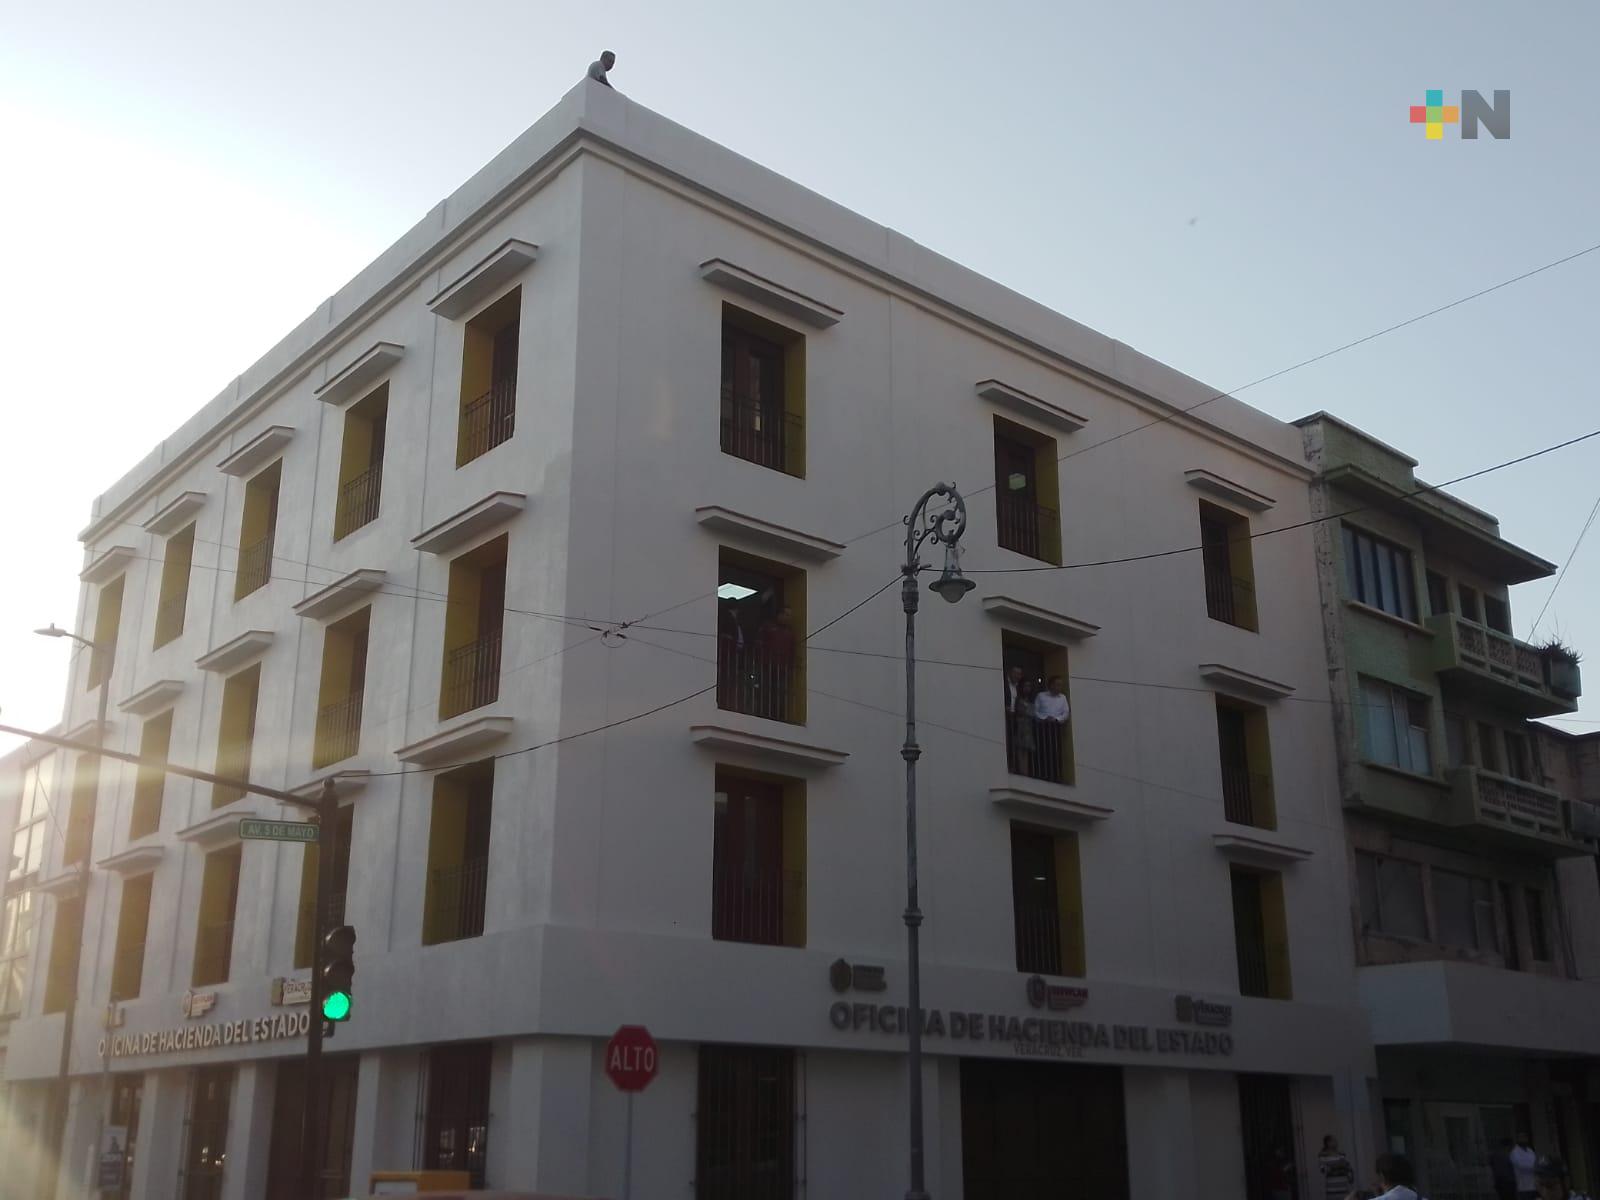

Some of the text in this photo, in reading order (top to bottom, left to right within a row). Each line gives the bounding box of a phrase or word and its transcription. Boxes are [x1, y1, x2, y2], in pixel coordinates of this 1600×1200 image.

[272, 825, 286, 837] DE
[287, 825, 314, 838] MAYO
[96, 1010, 311, 1057] OICINA DE HACIENDA DEL ESTADO
[949, 1011, 985, 1041] DE
[988, 1014, 1110, 1049] HACIENDA
[1112, 1024, 1153, 1052] DEL
[1155, 1028, 1233, 1057] ESTADO
[609, 1045, 655, 1072] ALTO
